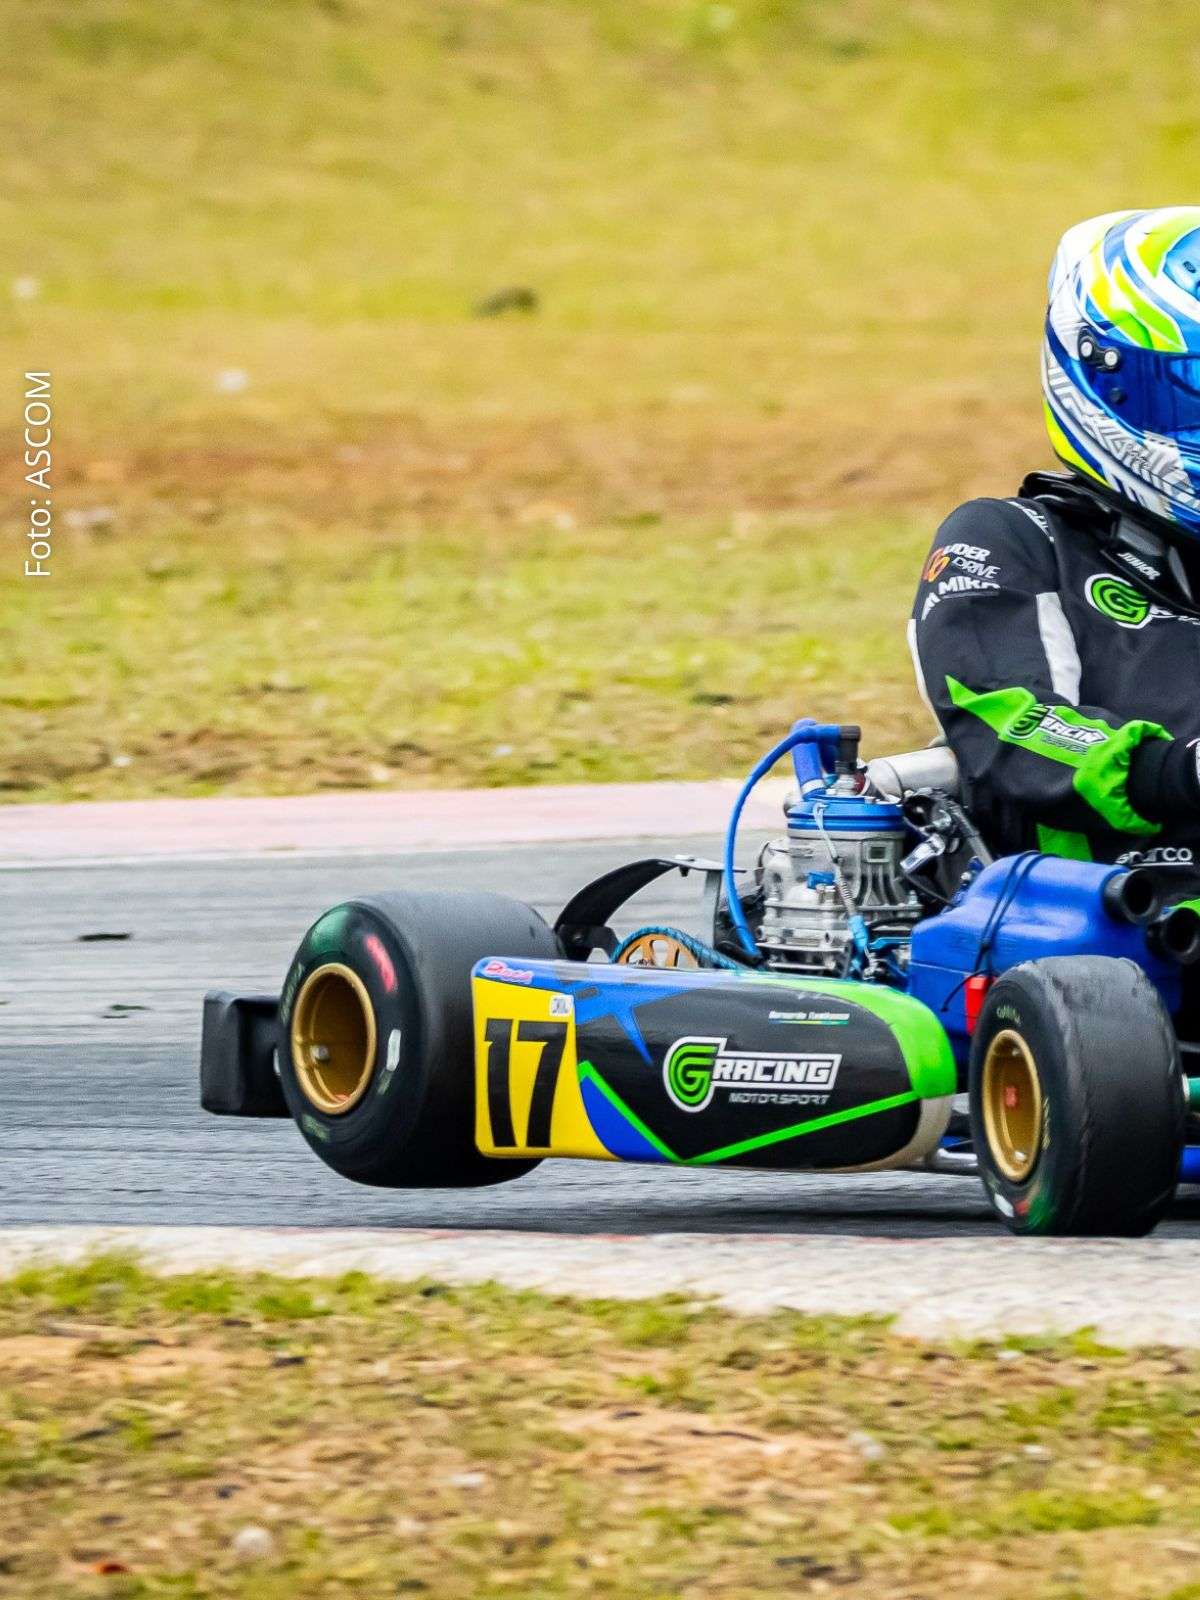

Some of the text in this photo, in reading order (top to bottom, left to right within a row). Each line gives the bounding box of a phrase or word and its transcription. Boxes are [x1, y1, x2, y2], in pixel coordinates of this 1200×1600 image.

[1117, 552, 1161, 580] JUNIOR
[485, 1017, 569, 1148] 17
[713, 1058, 832, 1083] RACING
[729, 1092, 830, 1105] MOTORSPORT
